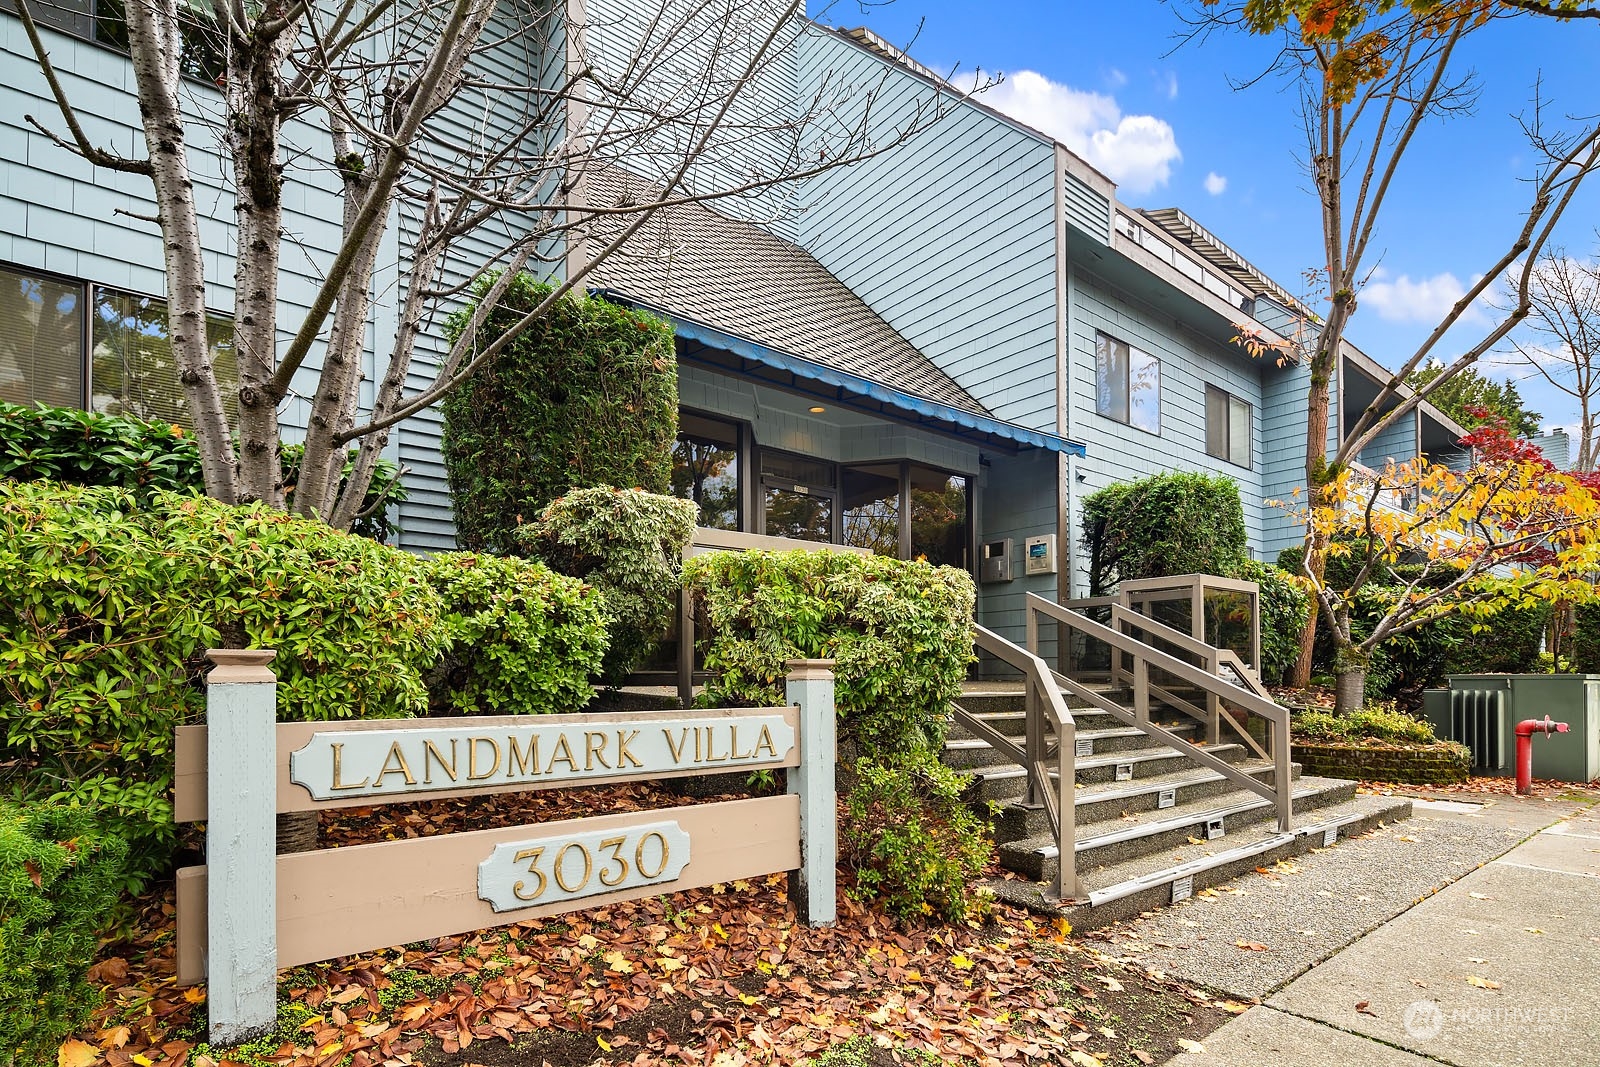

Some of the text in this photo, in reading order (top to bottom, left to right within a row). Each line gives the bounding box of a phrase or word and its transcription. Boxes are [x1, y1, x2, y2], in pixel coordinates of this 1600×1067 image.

[330, 724, 778, 790] LANDMARK VILLA
[513, 831, 670, 901] 3030
